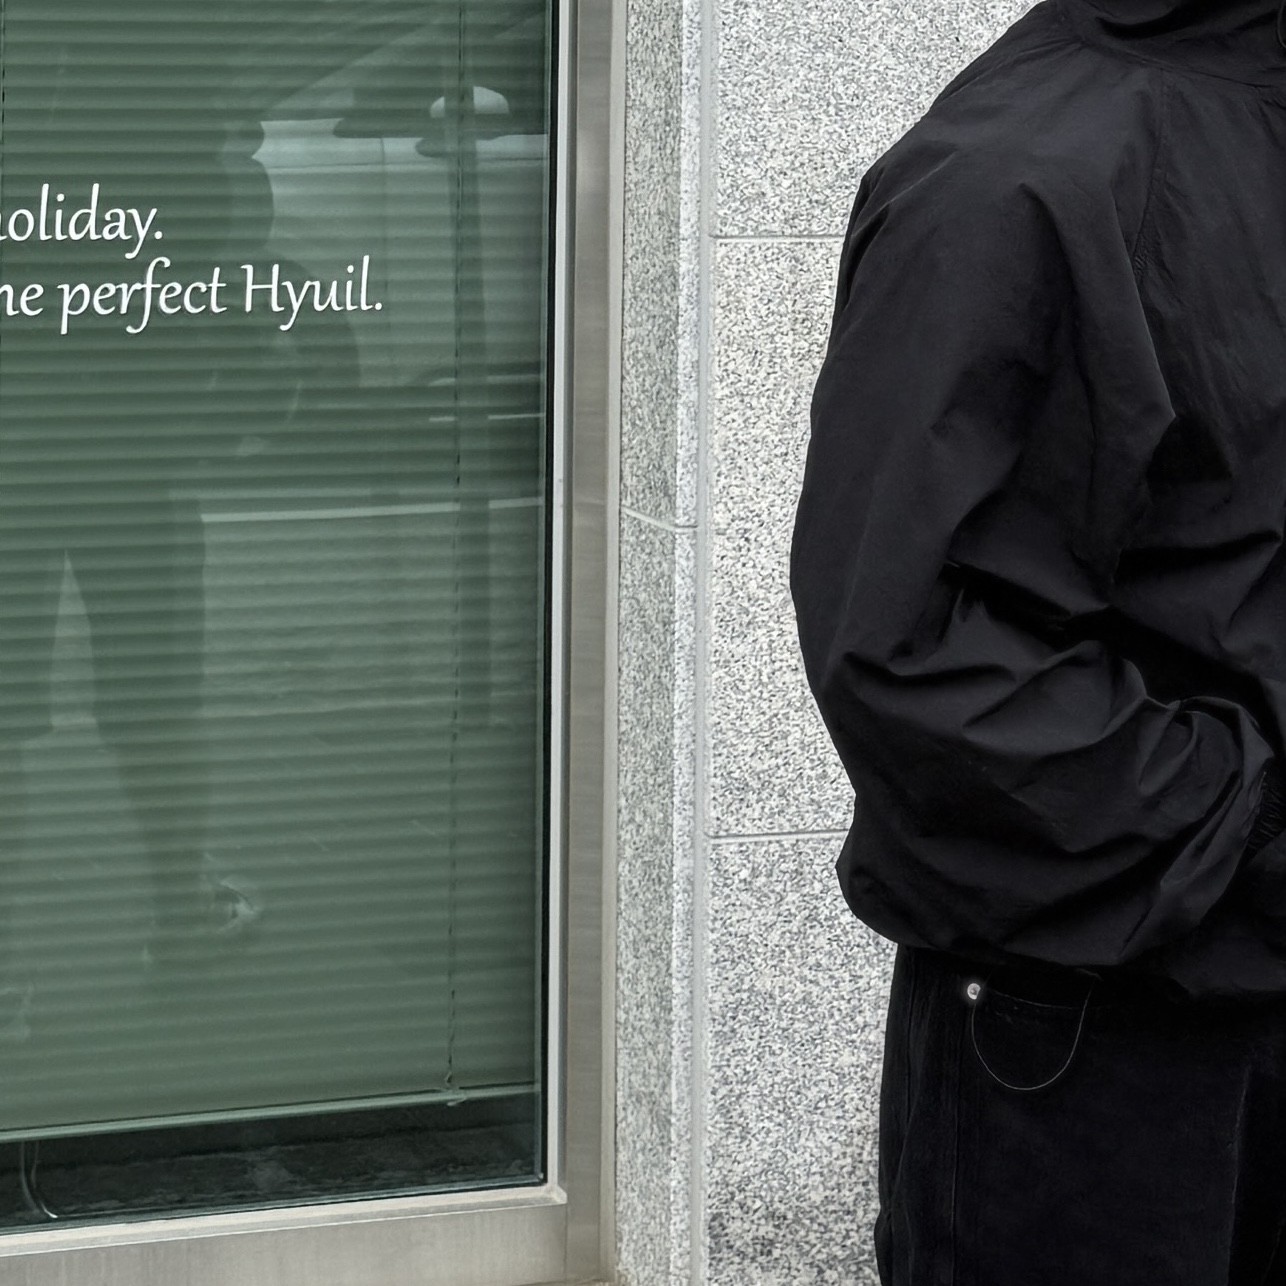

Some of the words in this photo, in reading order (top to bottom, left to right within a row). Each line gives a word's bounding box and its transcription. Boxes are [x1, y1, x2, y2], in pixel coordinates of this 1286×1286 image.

[0, 183, 163, 259] oliday.
[57, 256, 227, 335] perfect
[240, 255, 383, 331] Hyuil.
